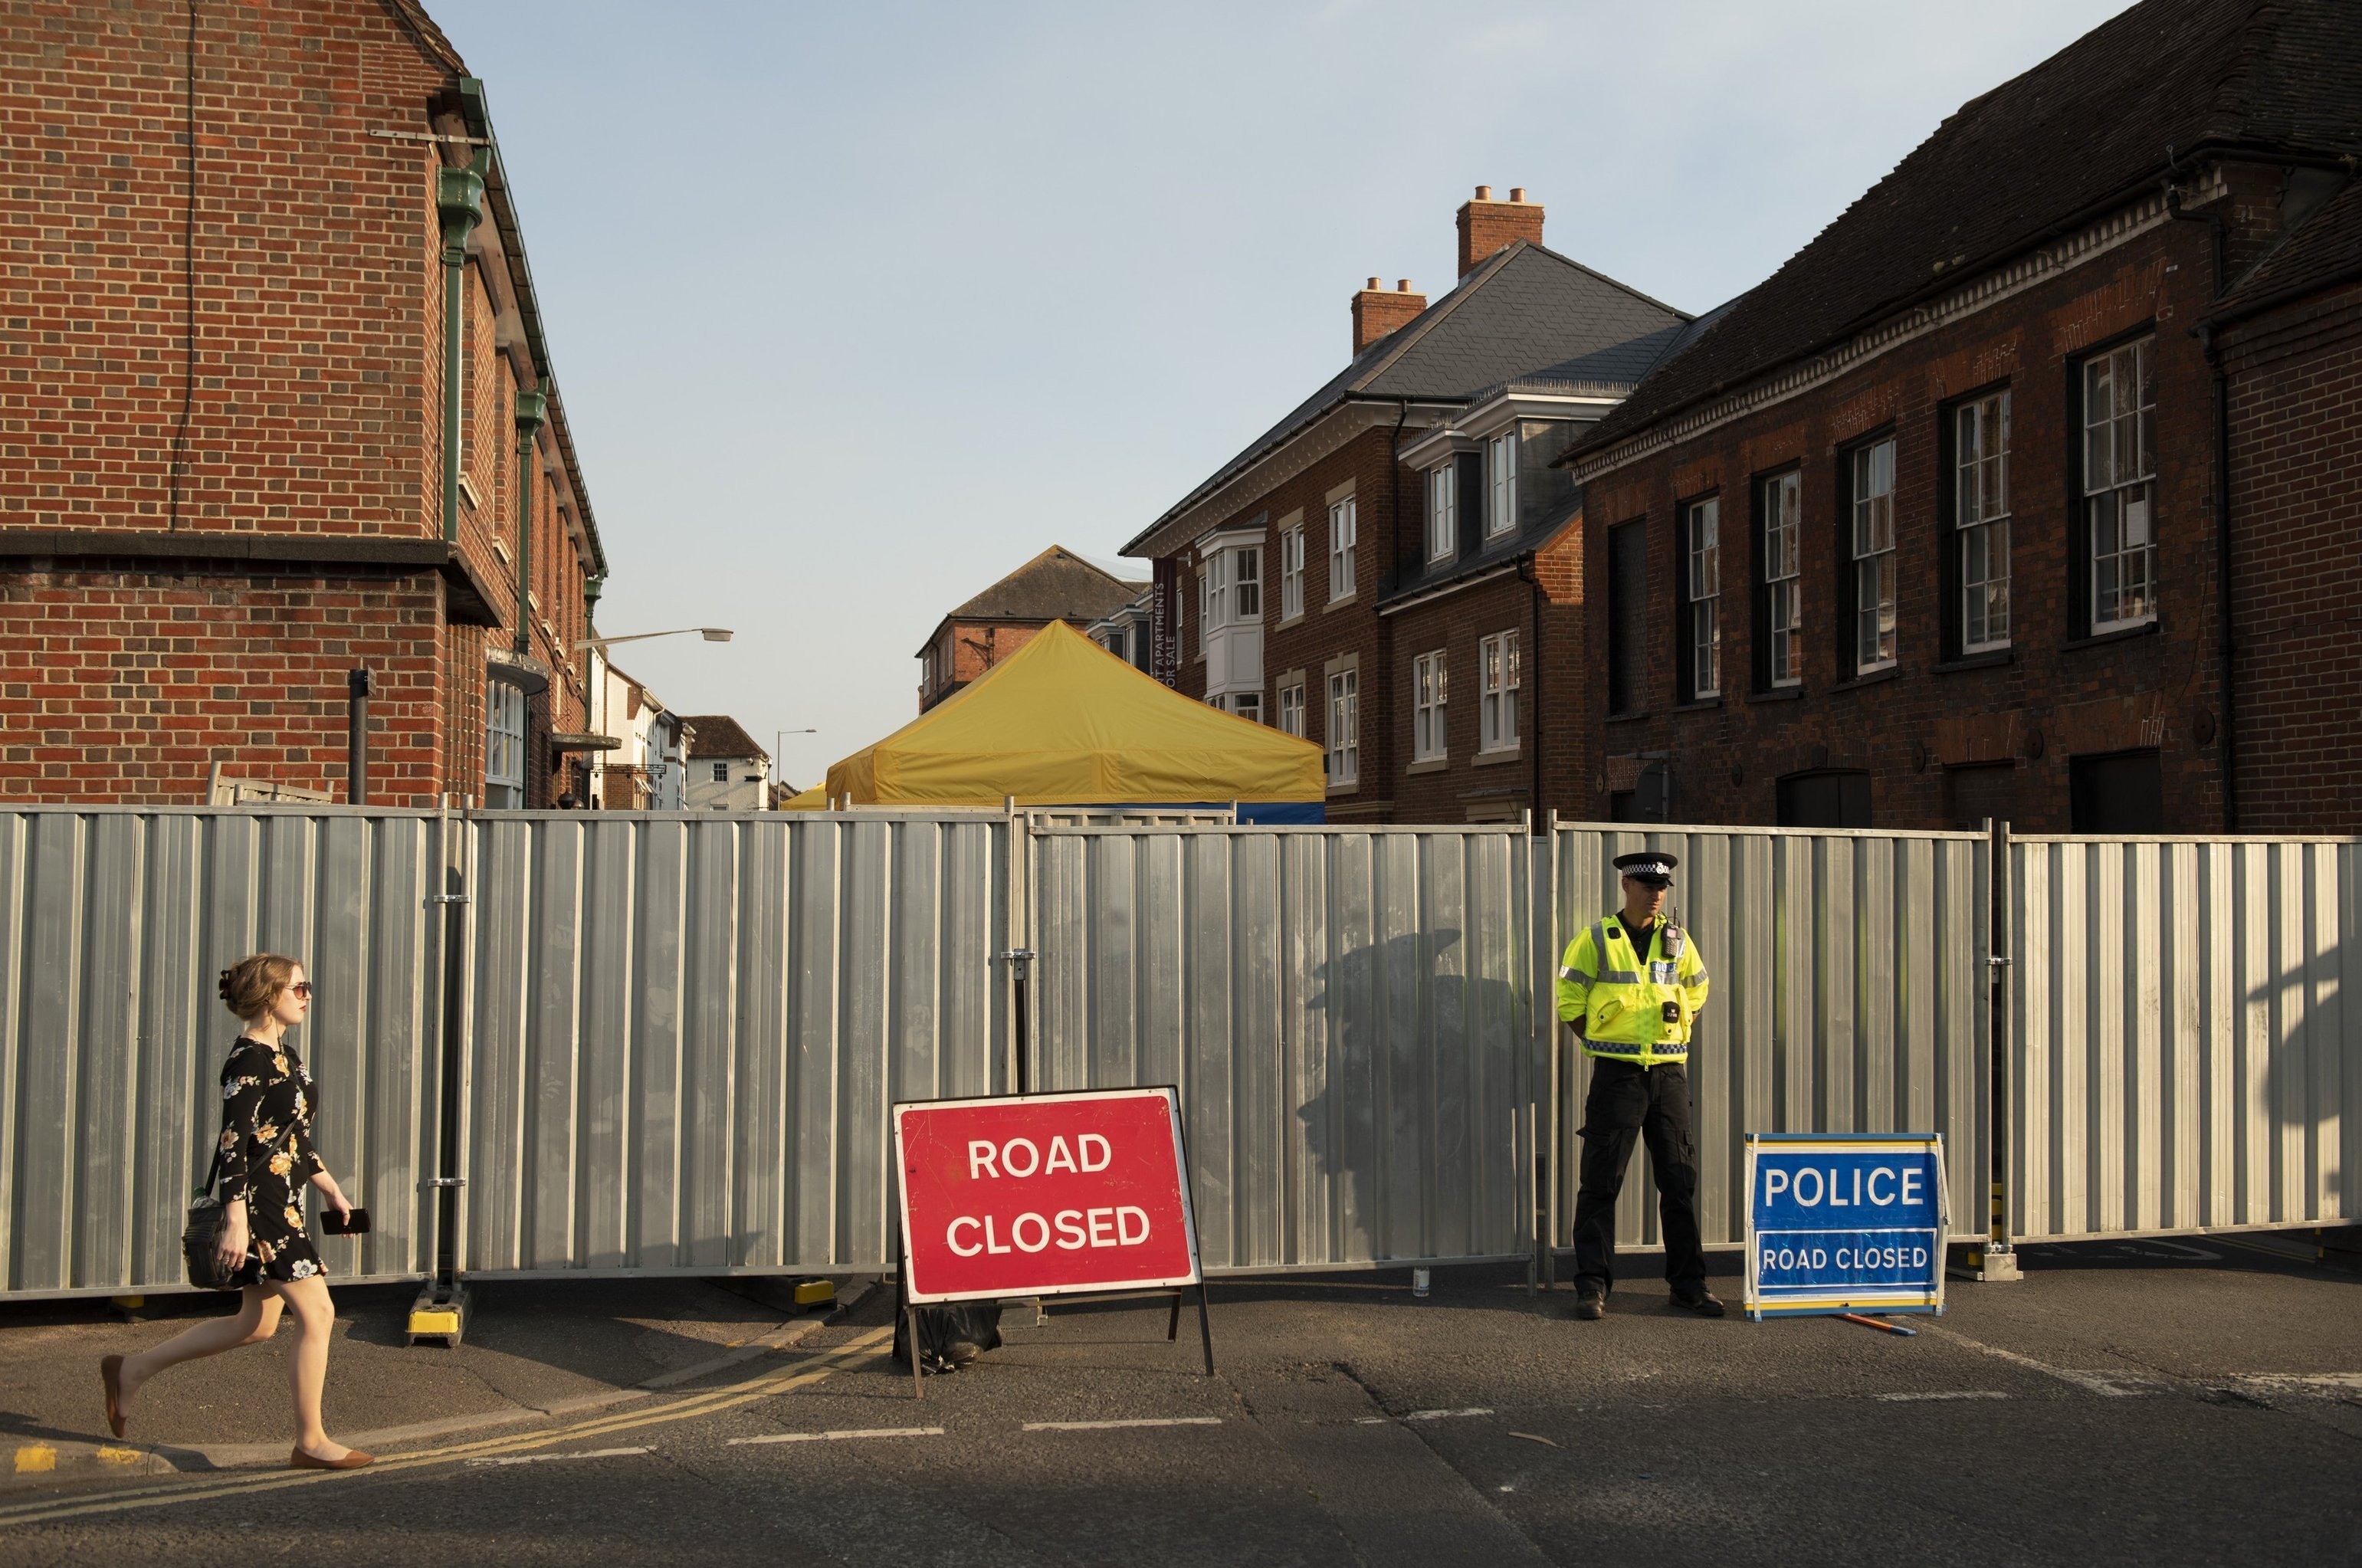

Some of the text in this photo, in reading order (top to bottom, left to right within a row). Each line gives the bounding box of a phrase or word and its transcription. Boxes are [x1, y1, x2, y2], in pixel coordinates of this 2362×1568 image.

[1155, 582, 1164, 666] APARTMENTS
[1166, 636, 1176, 665] SALE
[968, 1133, 1112, 1179] ROAD
[1765, 1167, 1924, 1207] POLICE
[946, 1206, 1150, 1258] CLOSED
[1763, 1247, 1927, 1271] ROAD CLOSED
